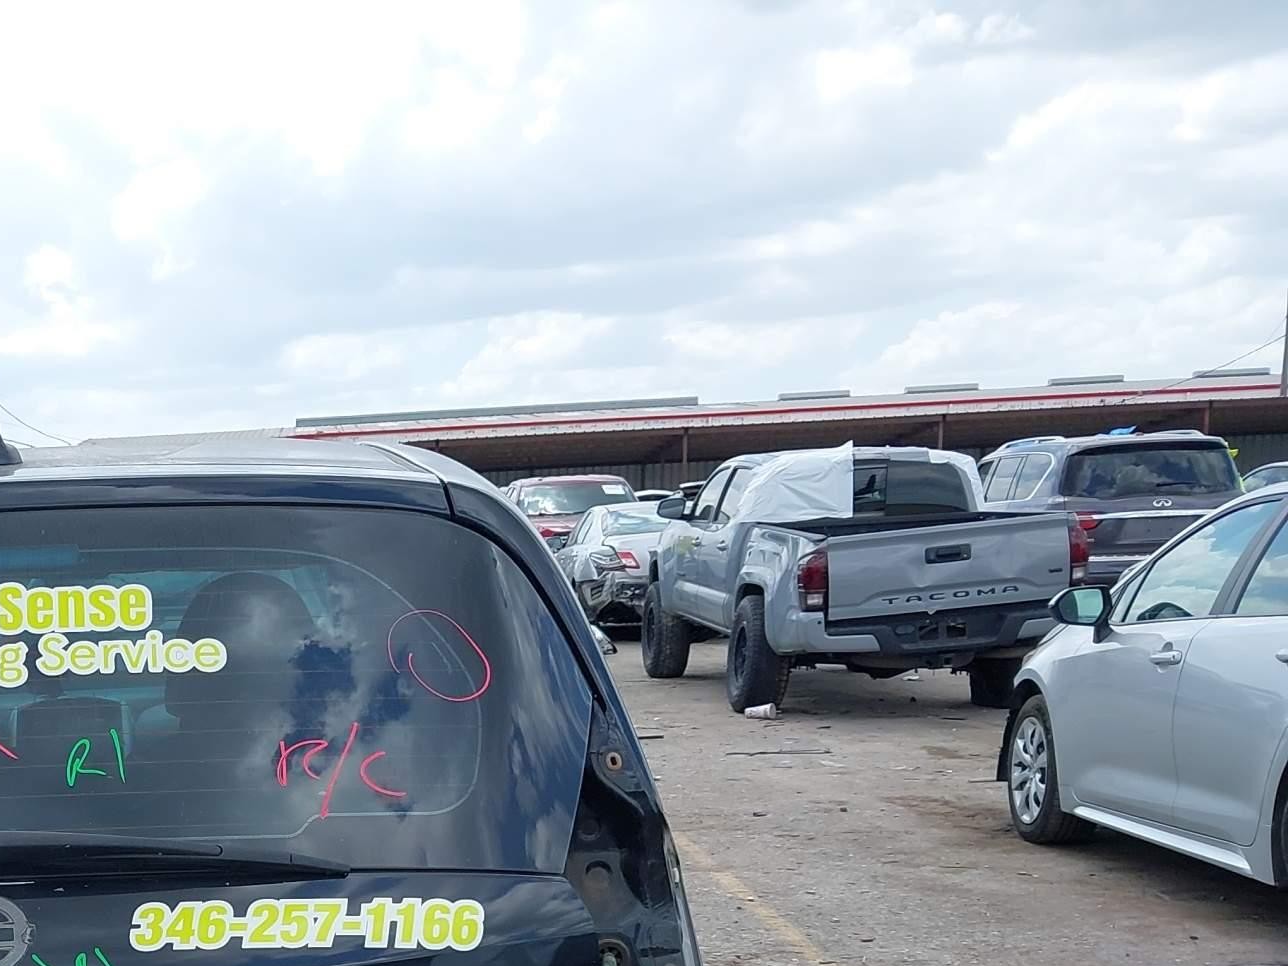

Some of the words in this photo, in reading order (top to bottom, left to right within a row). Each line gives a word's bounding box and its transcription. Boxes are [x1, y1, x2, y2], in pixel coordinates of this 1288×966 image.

[881, 585, 1020, 605] TACOMA
[39, 632, 225, 672] Service
[132, 900, 482, 949] 346-257-1166
